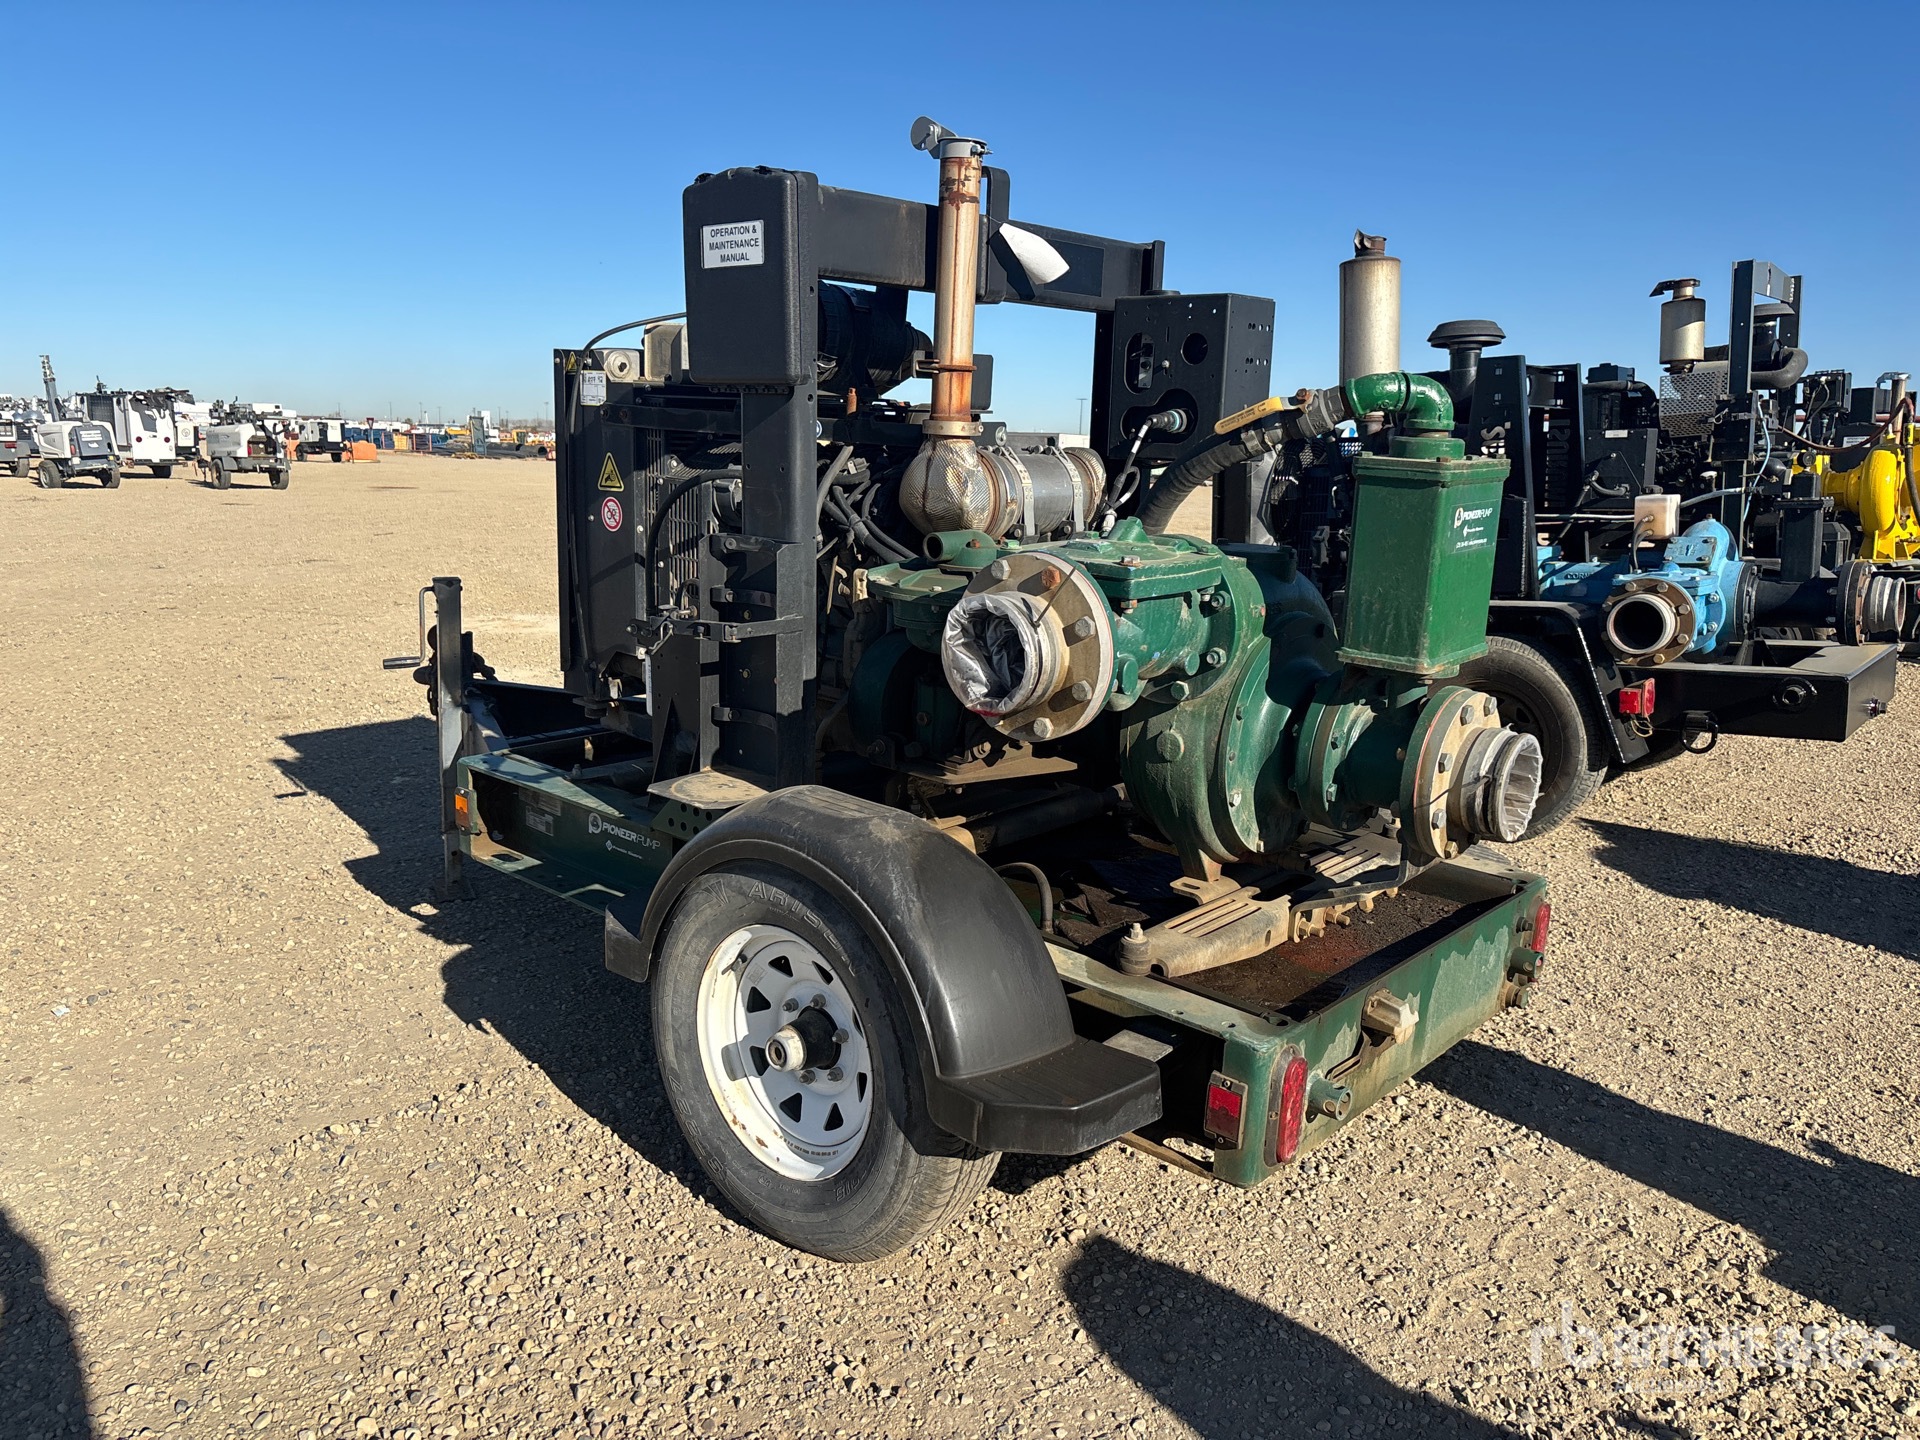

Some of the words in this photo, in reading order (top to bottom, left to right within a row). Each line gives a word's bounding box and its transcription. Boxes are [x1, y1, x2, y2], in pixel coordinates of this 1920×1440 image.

[710, 225, 750, 238] OPERATION
[751, 224, 757, 234] &
[708, 237, 760, 251] MAINTENANCE
[720, 252, 750, 263] MANUAL
[601, 821, 661, 850] PIONEERPUMP
